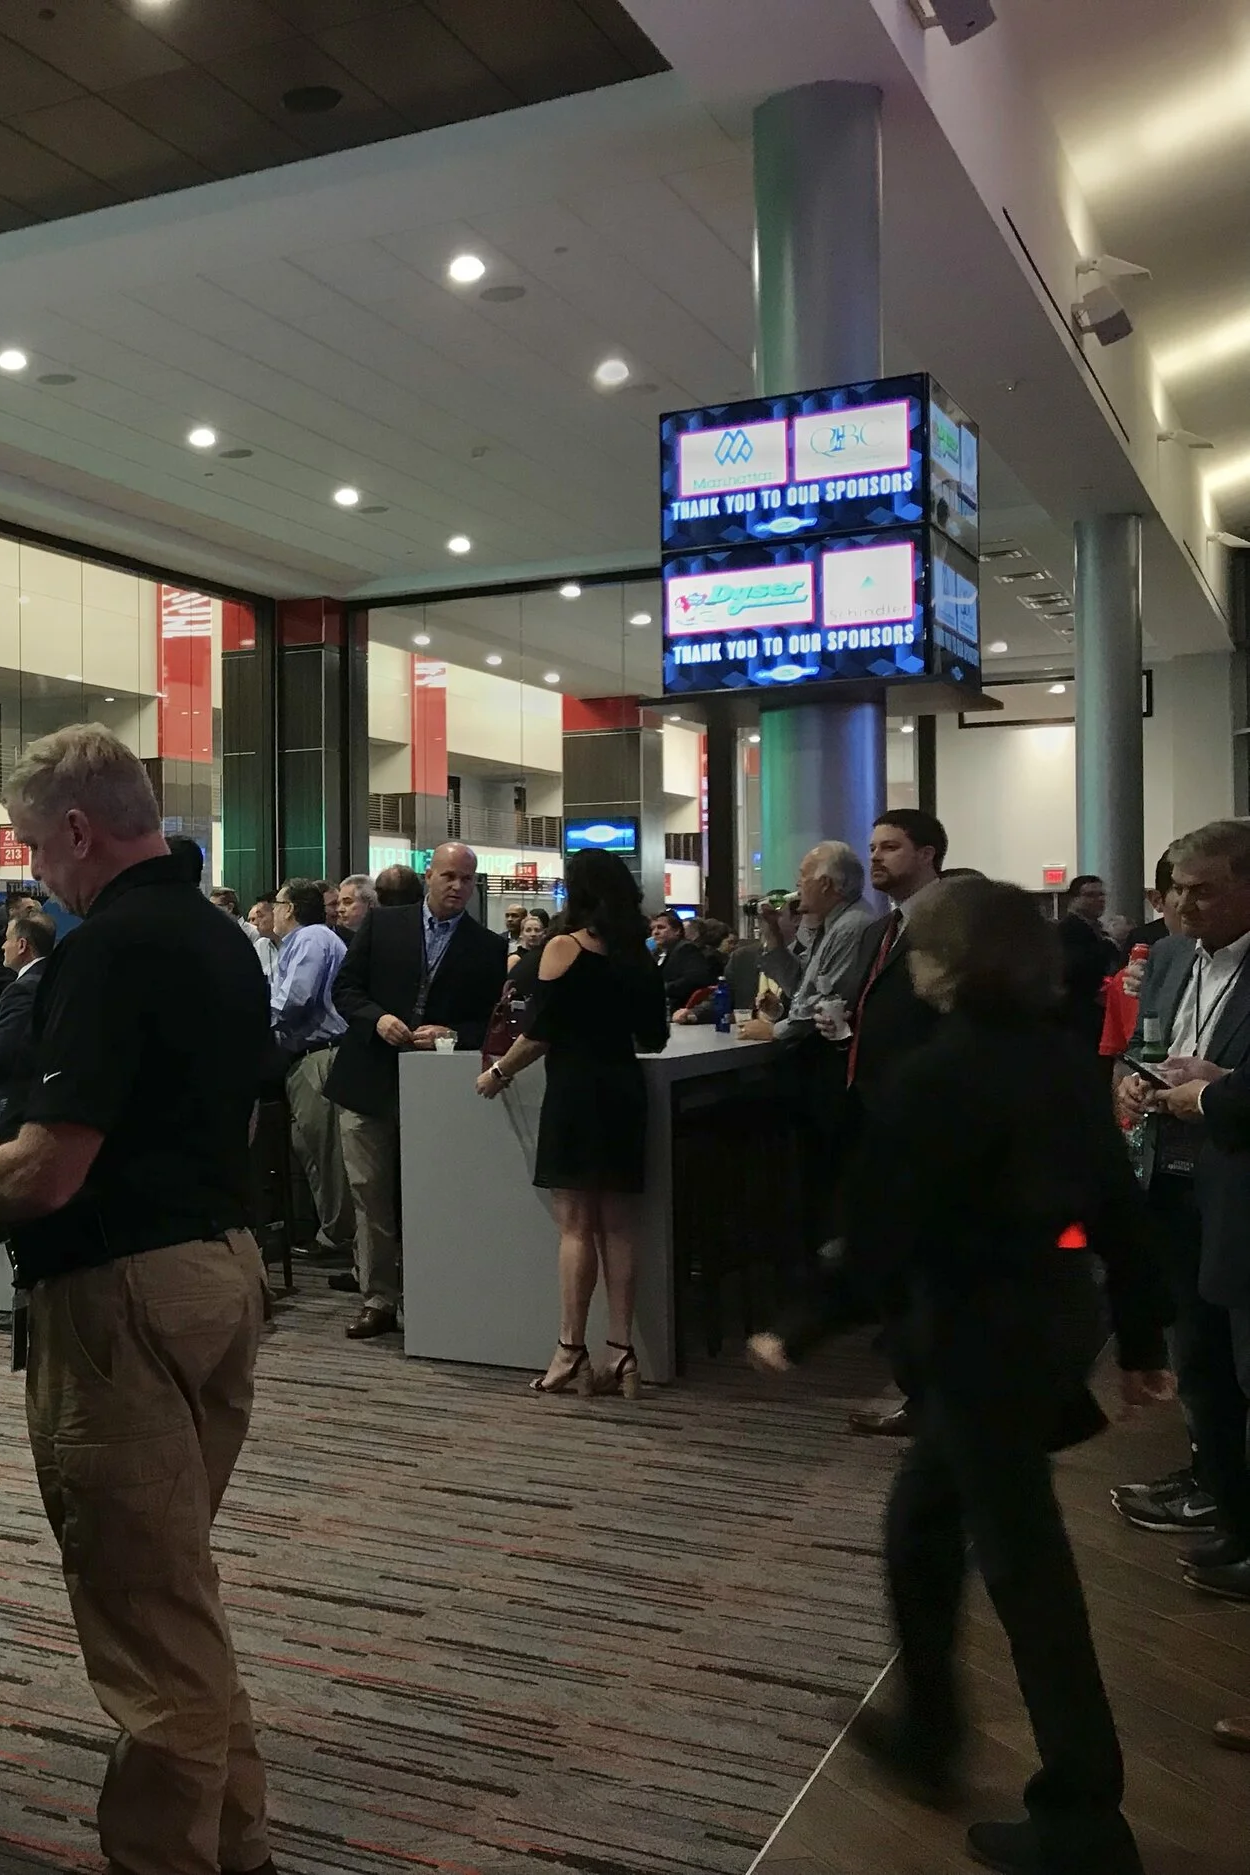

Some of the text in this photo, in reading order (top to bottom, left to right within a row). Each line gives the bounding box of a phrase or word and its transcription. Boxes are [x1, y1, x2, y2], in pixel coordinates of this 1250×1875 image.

[671, 471, 913, 520] THANK YOU TO OUR SPONSORS
[705, 581, 807, 615] Dyser
[672, 623, 914, 665] THANK YOU TO OUR SPONSORS
[5, 849, 22, 860] 213
